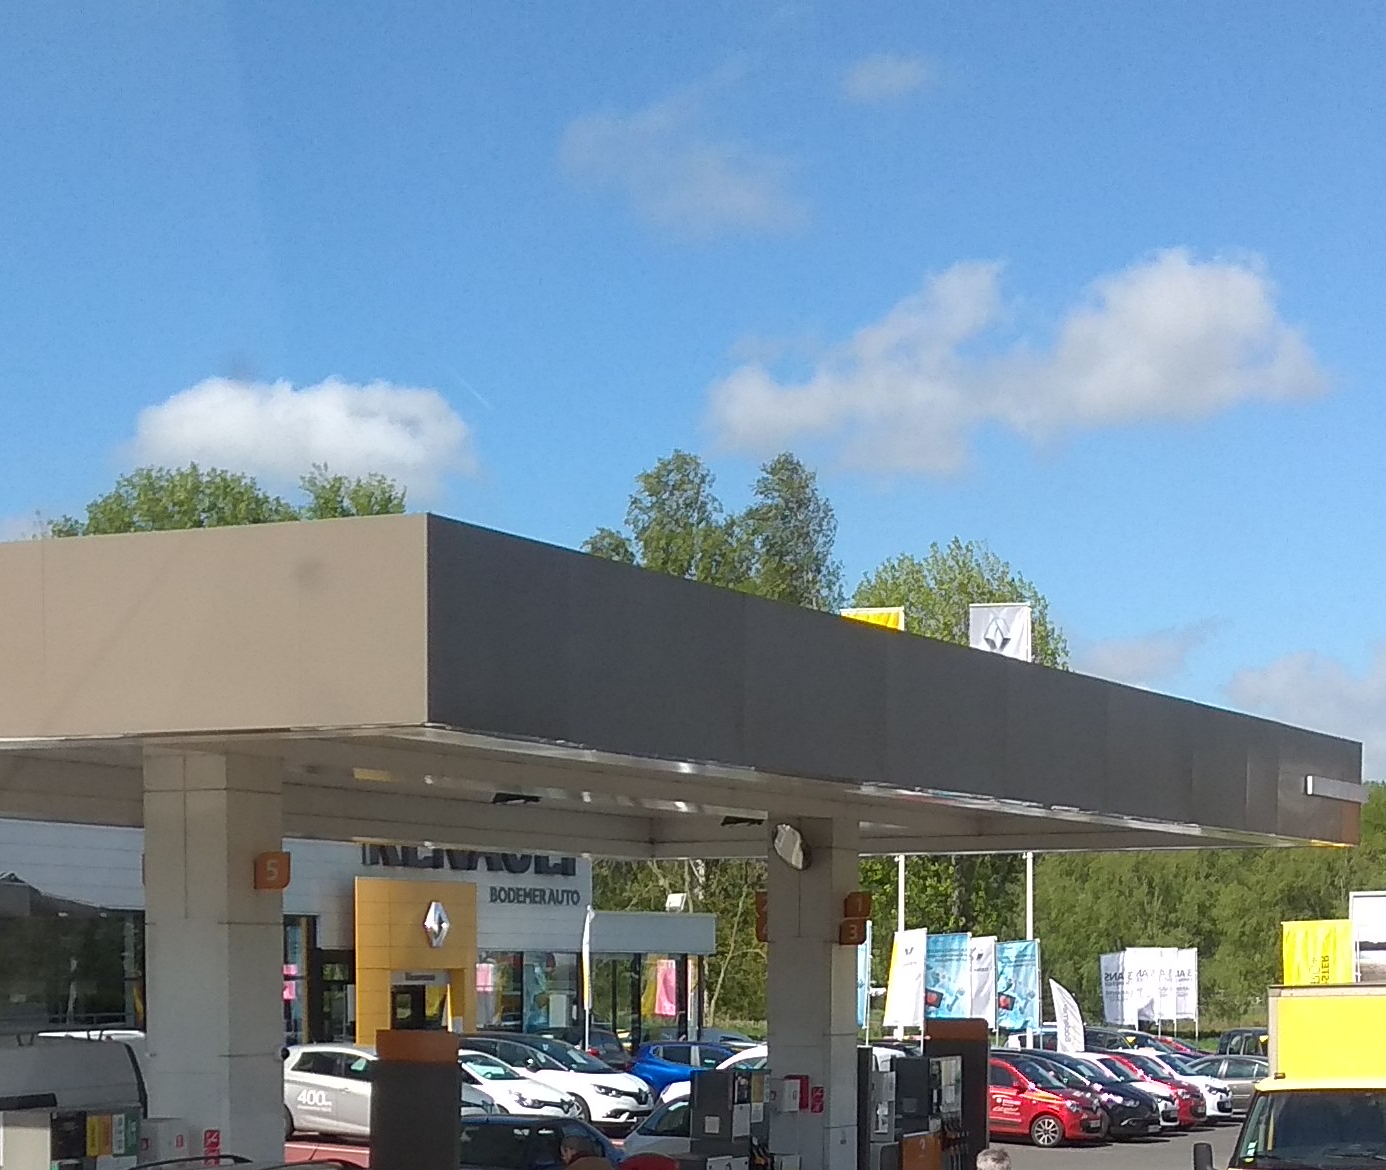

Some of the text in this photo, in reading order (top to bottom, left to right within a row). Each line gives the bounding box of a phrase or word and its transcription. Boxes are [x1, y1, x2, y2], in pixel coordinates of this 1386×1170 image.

[265, 859, 279, 882] 5
[849, 924, 858, 940] 3
[297, 1088, 326, 1106] 400
